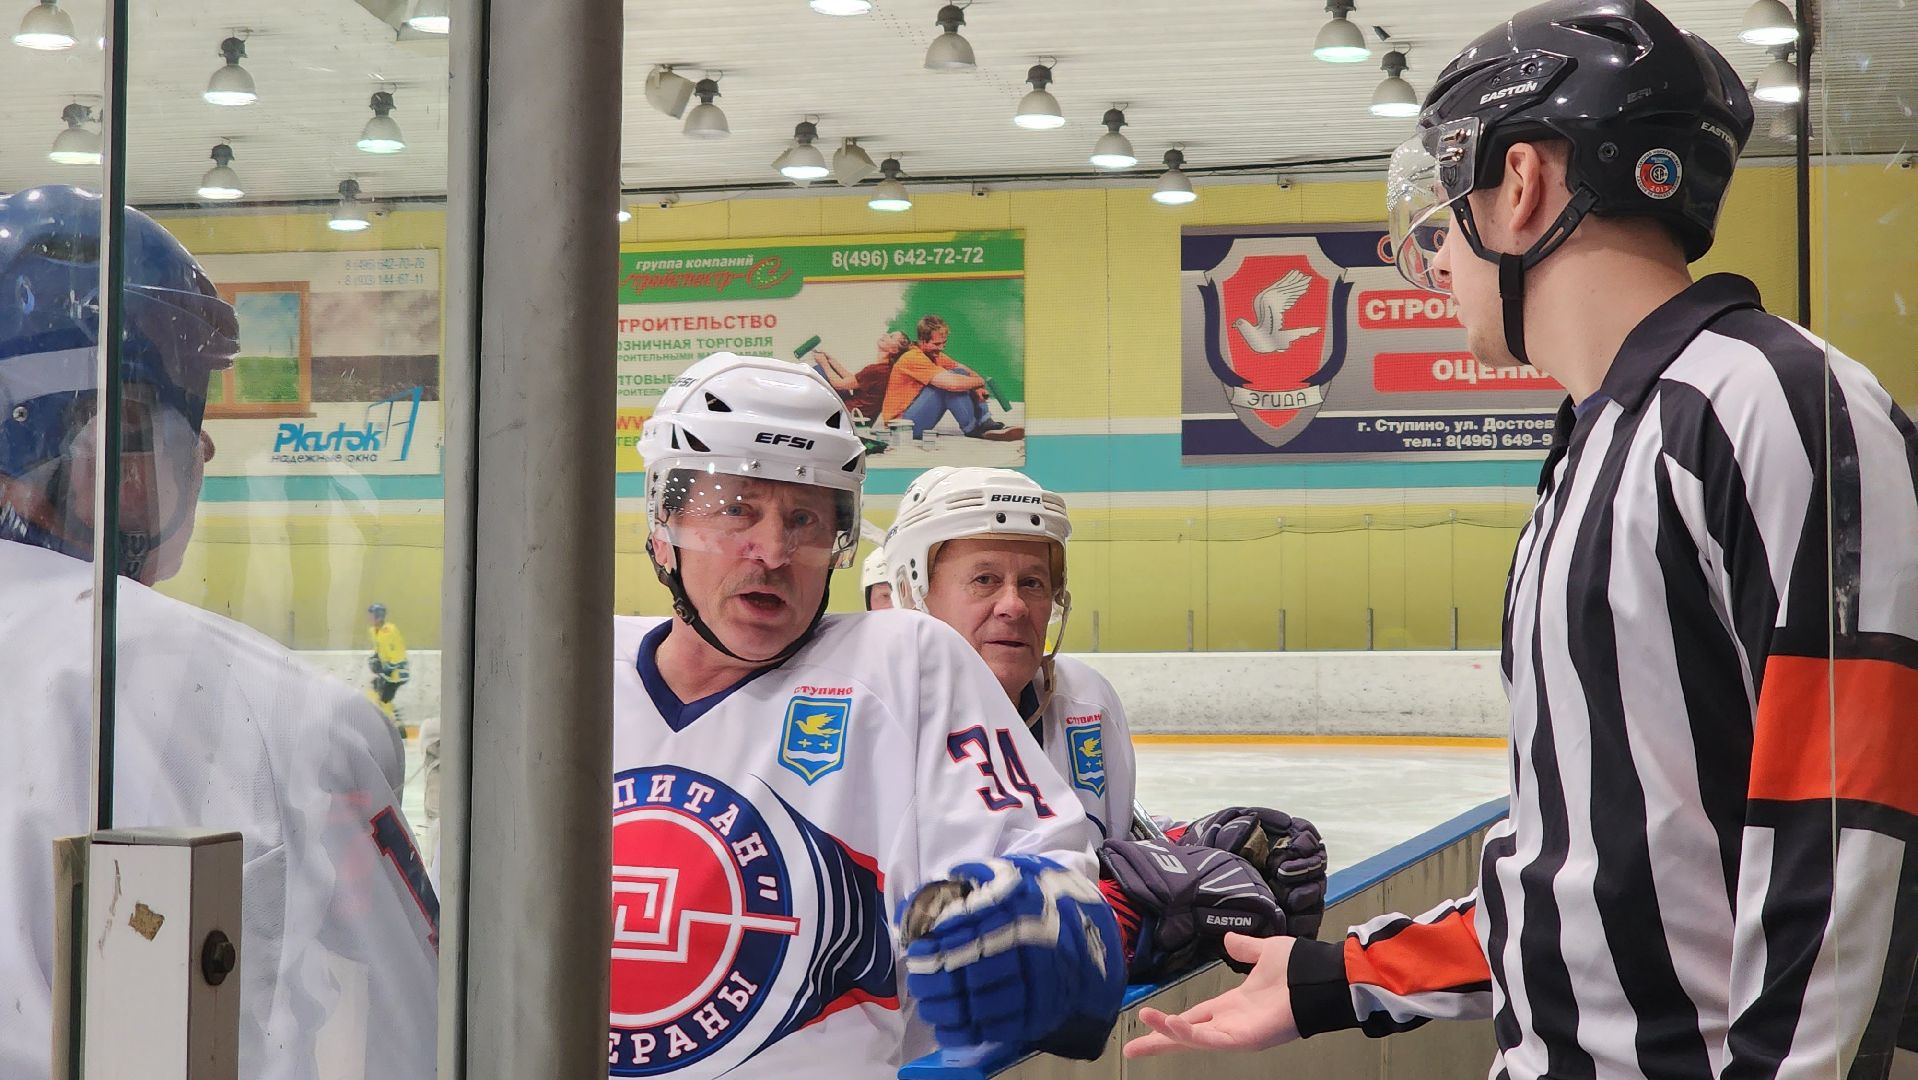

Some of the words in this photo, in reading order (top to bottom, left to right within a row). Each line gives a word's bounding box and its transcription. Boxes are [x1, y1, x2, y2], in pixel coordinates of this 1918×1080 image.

[1480, 81, 1538, 105] EASTON
[635, 259, 683, 272] группа
[685, 255, 754, 270] компаний
[832, 250, 888, 271] 8(496)
[893, 247, 984, 266] 642-72-72
[619, 314, 778, 333] ТРОИТЕЛЬСТВО
[696, 336, 774, 349] ТОРГОВЛЯ
[1247, 392, 1307, 408] ЭГИДА
[1358, 421, 1371, 432] г.
[1375, 418, 1450, 434] Ступино,
[1454, 419, 1478, 433] ул.
[755, 432, 815, 450] EFSI
[1403, 437, 1441, 448] тел.:
[1446, 434, 1497, 449] 8(496)
[345, 454, 378, 462] окна
[991, 494, 1041, 505] BAUER
[794, 685, 853, 696] СТУПИНО
[947, 725, 1058, 819] 34
[1206, 914, 1252, 927] EASTON
